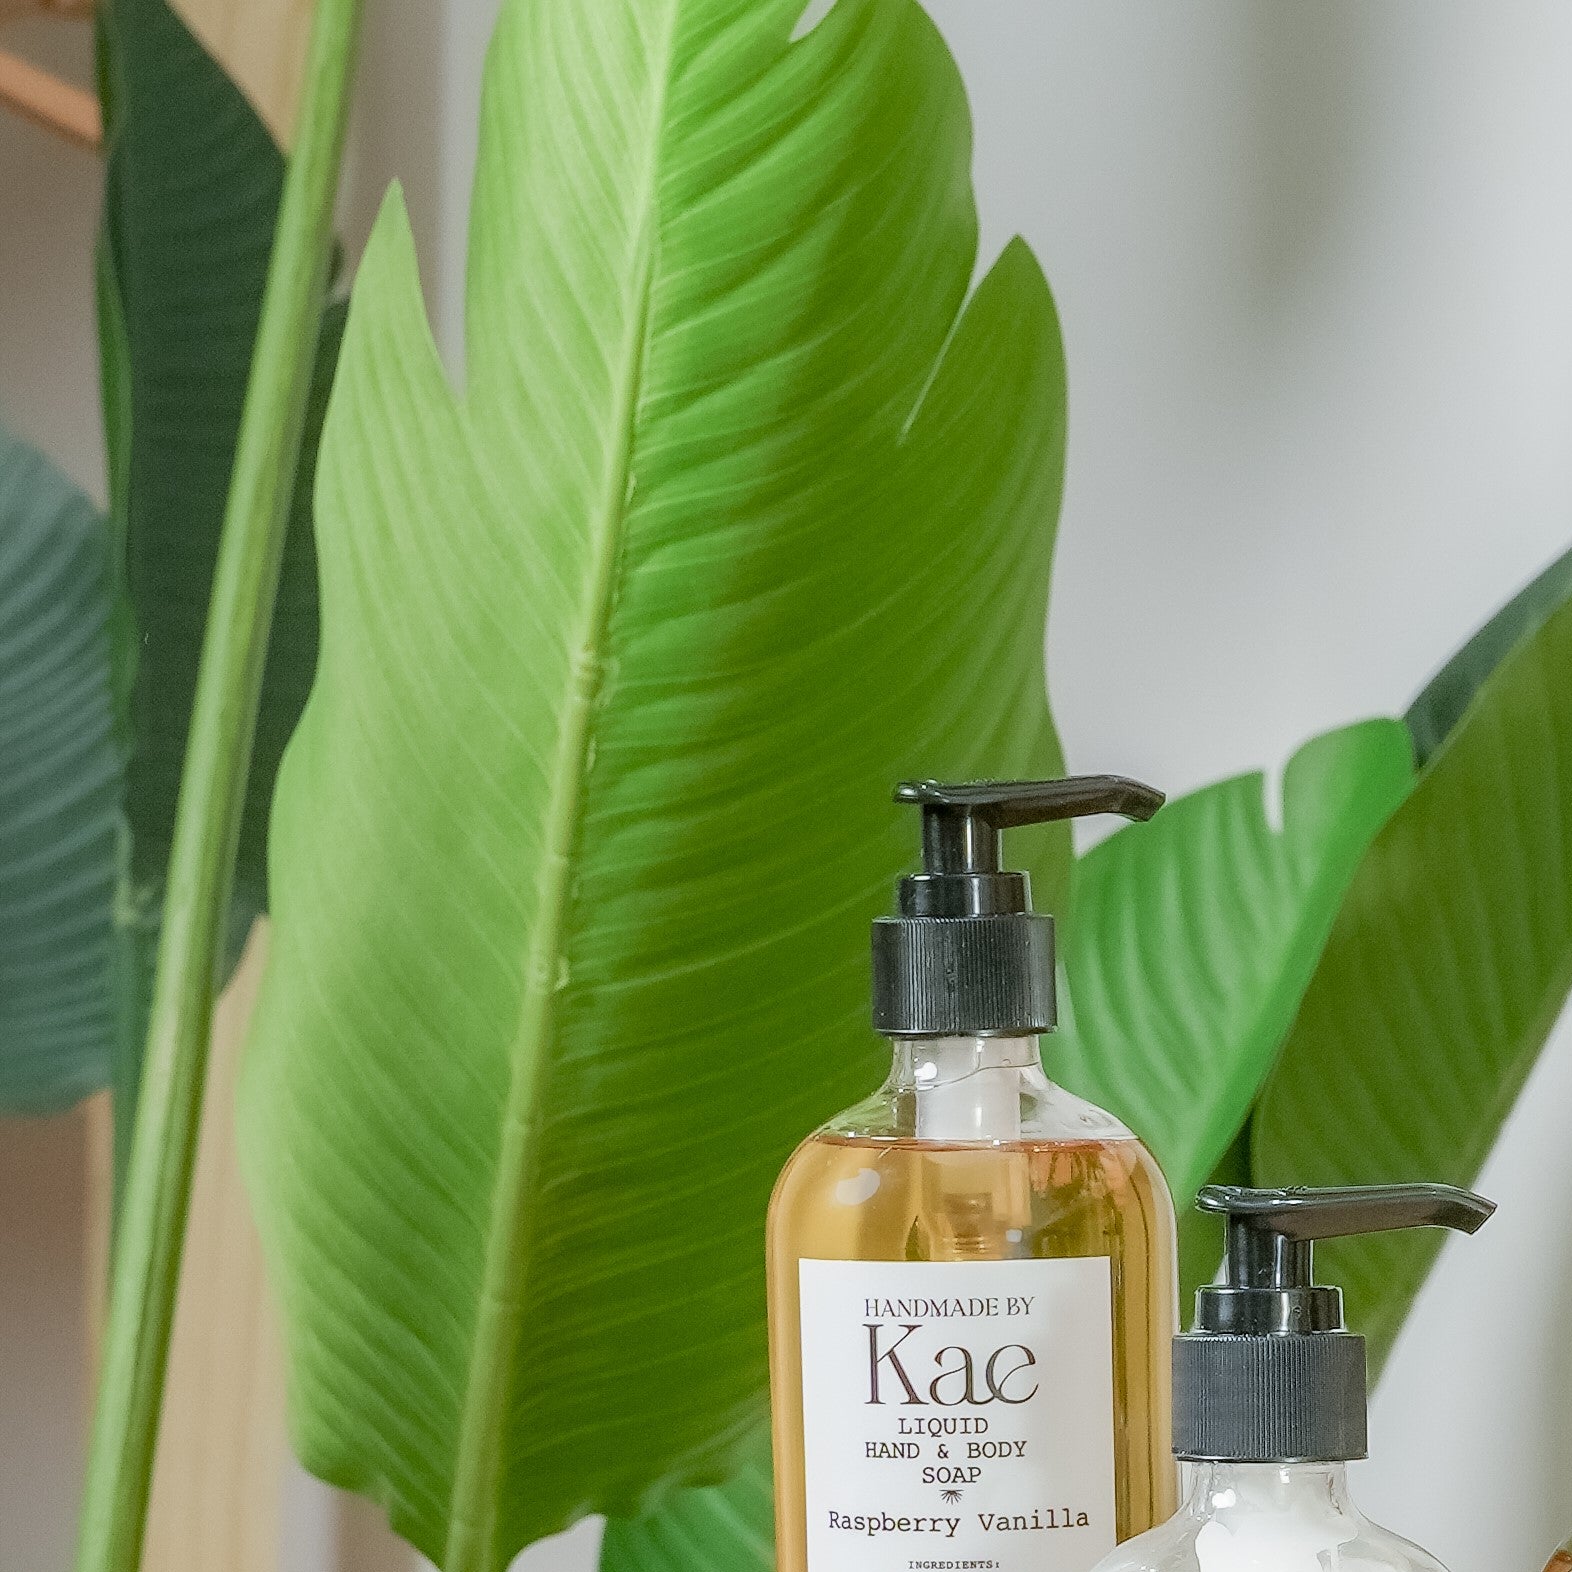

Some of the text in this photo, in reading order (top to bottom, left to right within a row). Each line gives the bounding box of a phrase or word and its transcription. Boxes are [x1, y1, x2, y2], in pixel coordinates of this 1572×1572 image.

[865, 1296, 1036, 1318] HANDMADE BY
[861, 1323, 1040, 1407] Kae
[897, 1417, 989, 1438] LIQUID
[864, 1440, 1028, 1460] HAND & BODY
[921, 1466, 982, 1484] SOAP
[828, 1507, 1090, 1538] Raspberry Vanilla
[908, 1559, 1000, 1570] INGREDIENTS:
